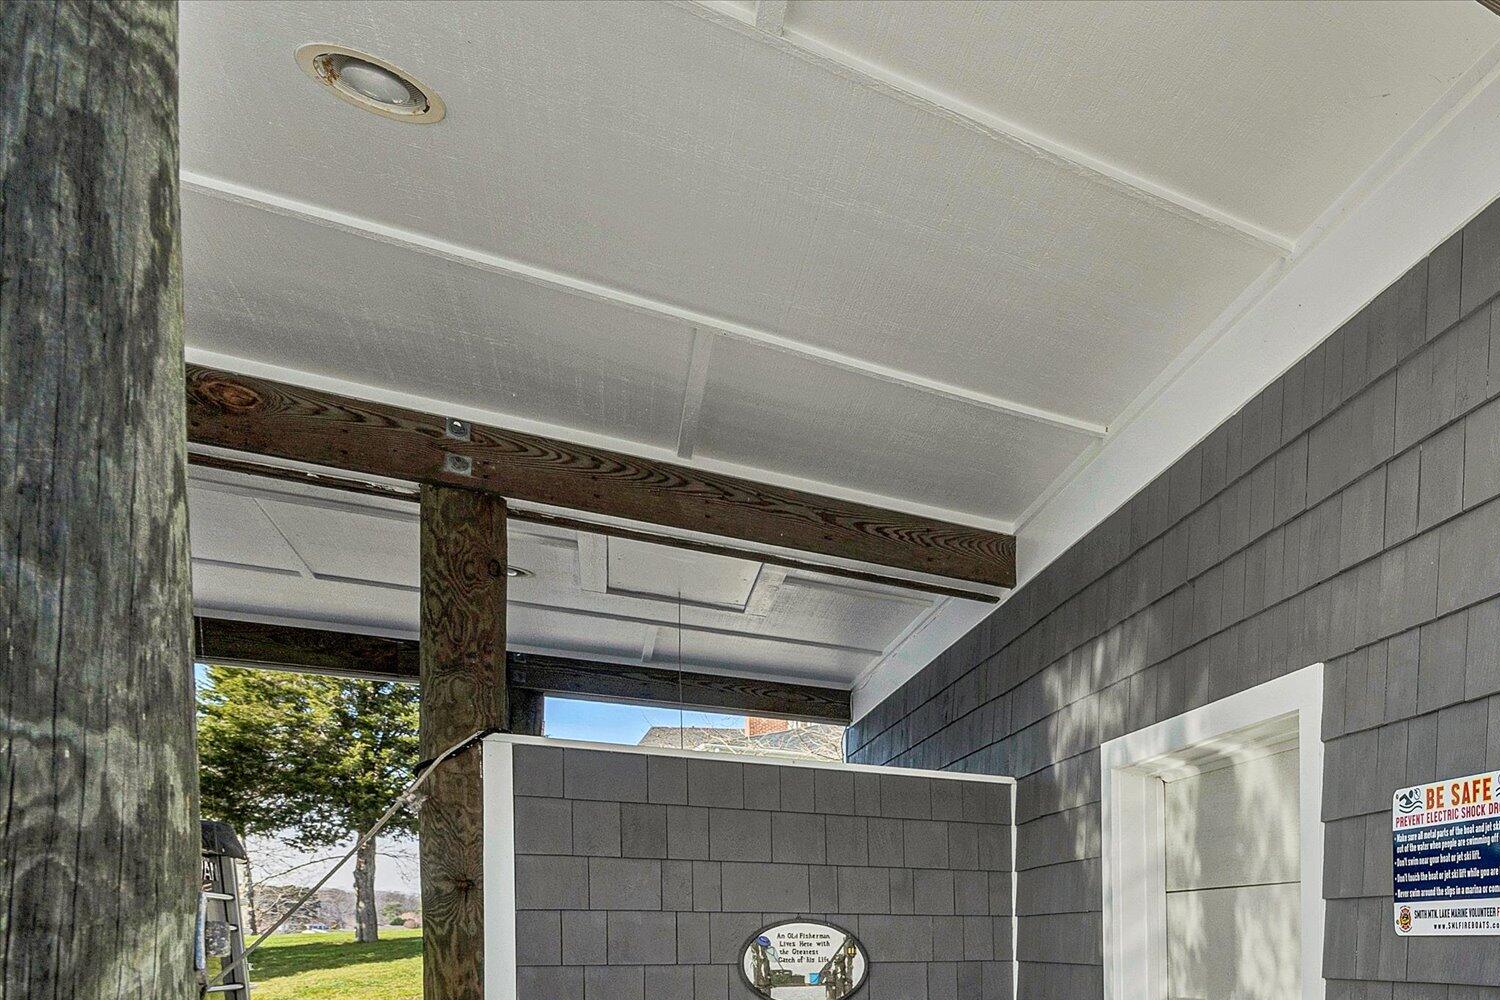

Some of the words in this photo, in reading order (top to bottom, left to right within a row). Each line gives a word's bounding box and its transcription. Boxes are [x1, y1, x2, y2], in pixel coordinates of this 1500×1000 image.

[1426, 786, 1444, 809] BE
[1451, 777, 1492, 805] SAFE
[1396, 813, 1424, 828] PREVENT
[1427, 808, 1459, 824] ELECTRIC
[1462, 804, 1486, 818] SHOCK
[1424, 829, 1436, 839] metal
[1437, 828, 1448, 840] parts
[1450, 826, 1454, 836] of
[1464, 824, 1474, 834] boat
[1476, 822, 1484, 833] and
[1404, 843, 1409, 851] of
[1417, 842, 1429, 851] water
[1430, 840, 1441, 850] when
[1442, 838, 1457, 850] people
[1466, 834, 1490, 846] swimming
[1491, 832, 1499, 843] off
[1408, 856, 1418, 866] swim
[1430, 856, 1439, 866] your
[1440, 853, 1450, 863] boat
[1451, 854, 1456, 862] or
[1428, 871, 1438, 880] boat
[1467, 867, 1479, 877] while
[1480, 868, 1489, 878] you
[1421, 887, 1436, 897] around
[1445, 886, 1455, 897] slips
[1456, 886, 1460, 894] in
[1465, 884, 1482, 894] marina
[1414, 910, 1427, 919] SMITH
[1439, 909, 1450, 918] LAKE
[1451, 908, 1468, 918] MARINE
[1469, 907, 1496, 918] VOLUNTEER
